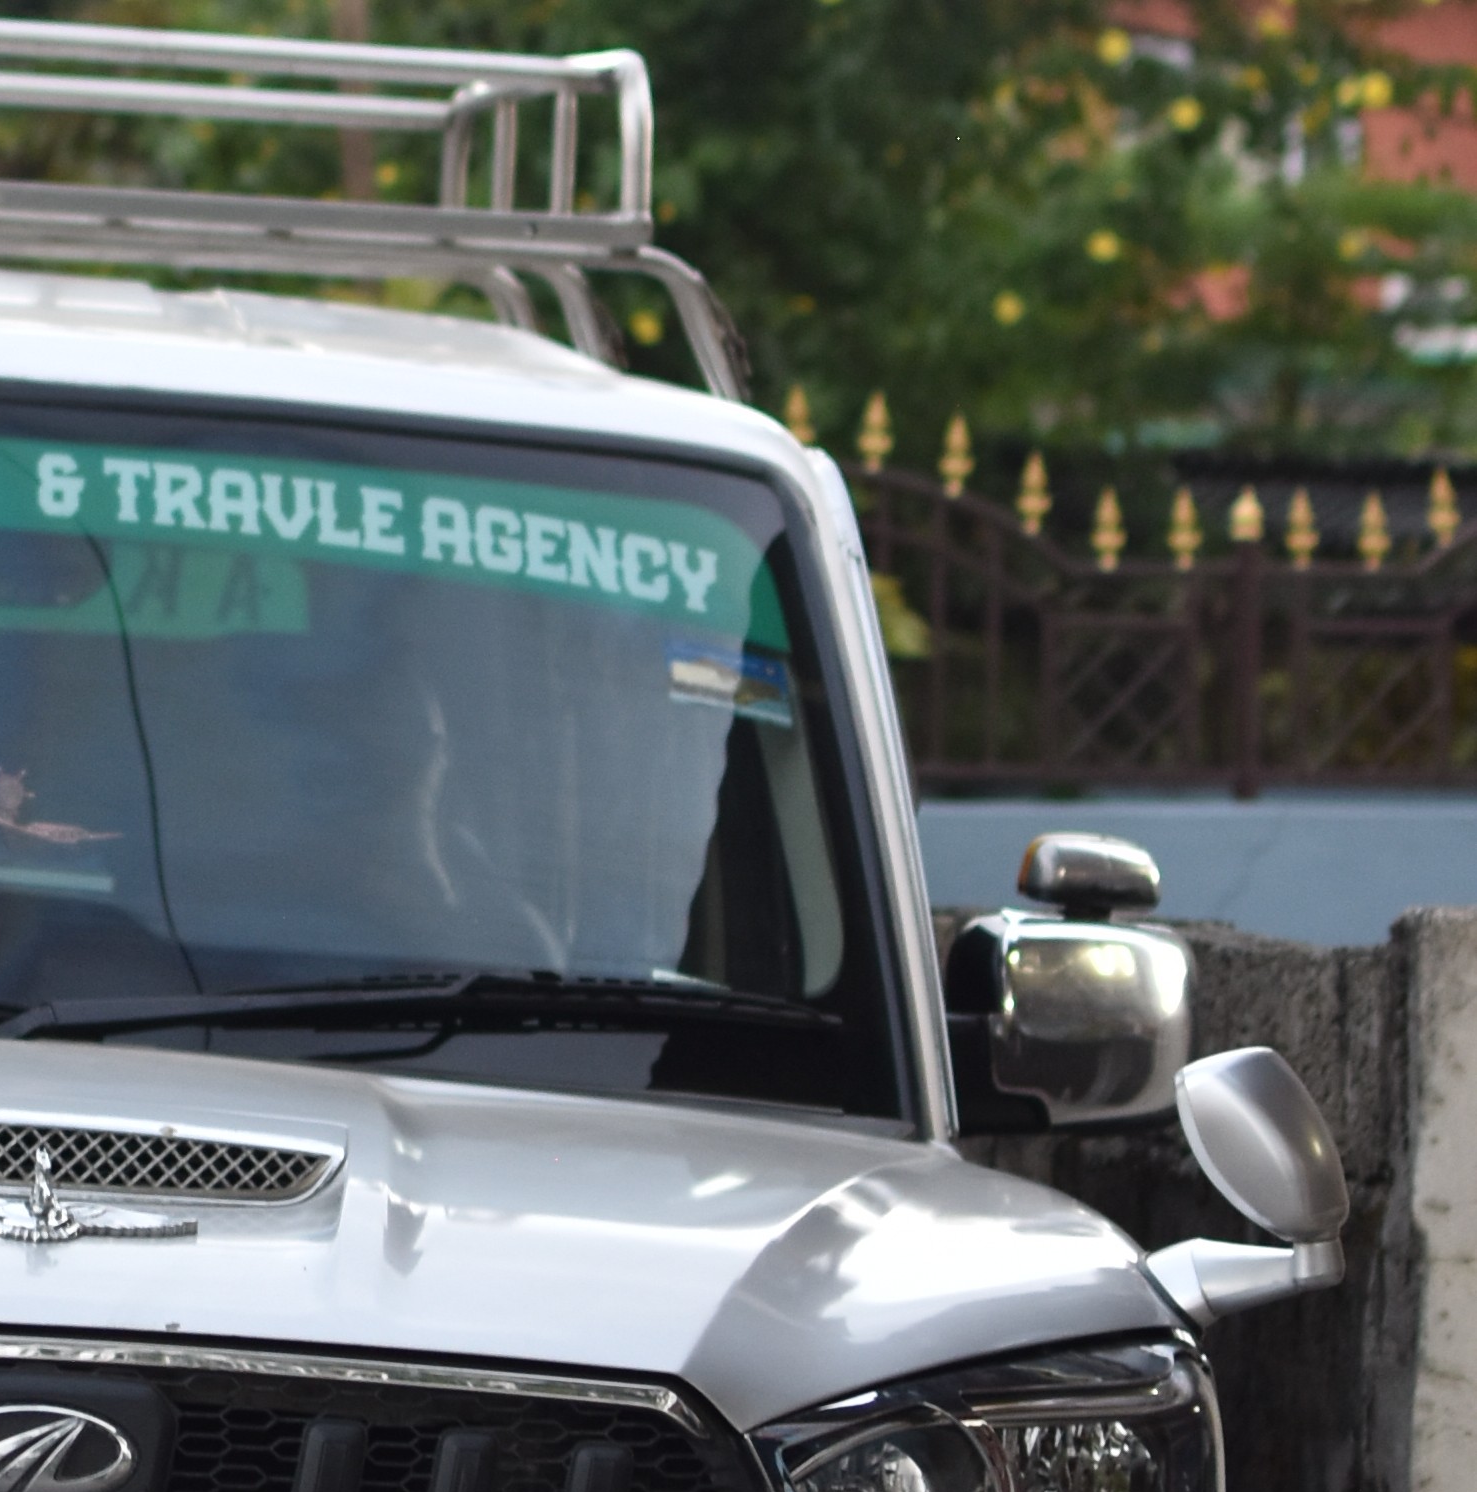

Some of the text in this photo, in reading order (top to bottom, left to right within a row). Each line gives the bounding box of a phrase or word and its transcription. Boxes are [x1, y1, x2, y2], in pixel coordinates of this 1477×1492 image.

[36, 452, 85, 518] &
[103, 456, 405, 556] TRAVLE
[420, 495, 720, 614] AGENCY
